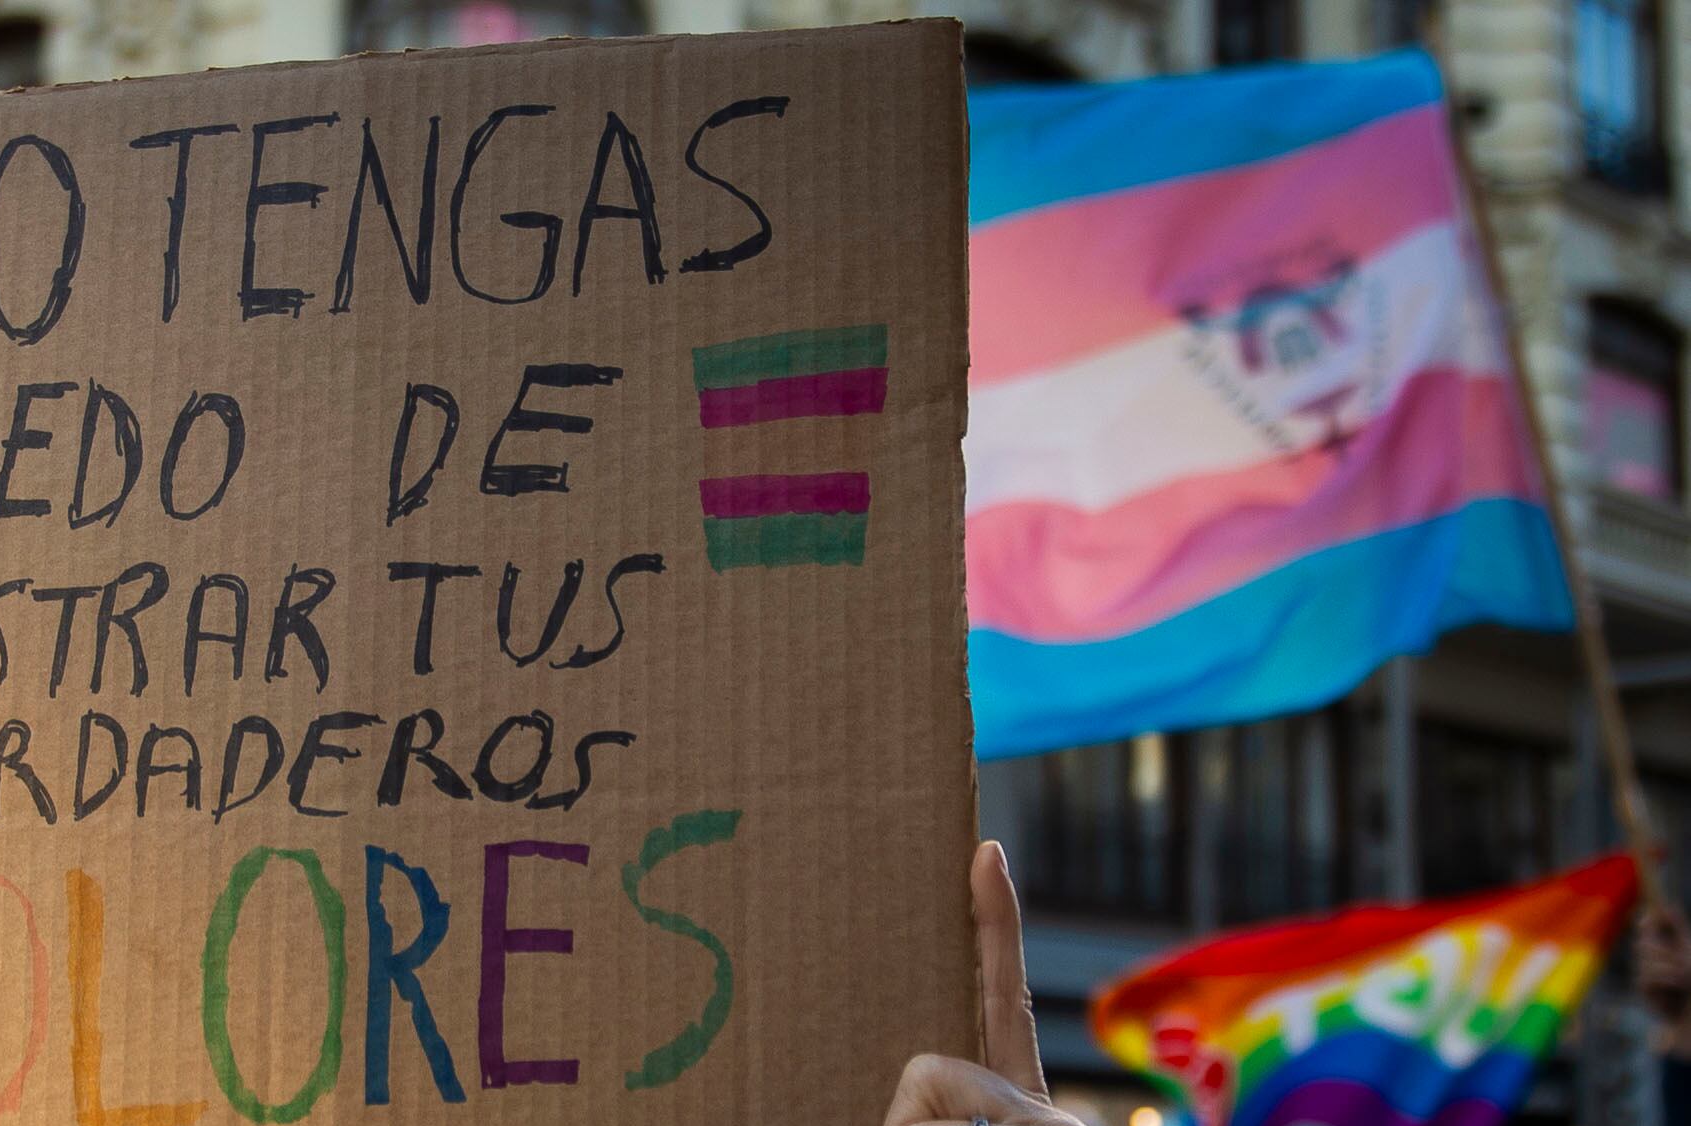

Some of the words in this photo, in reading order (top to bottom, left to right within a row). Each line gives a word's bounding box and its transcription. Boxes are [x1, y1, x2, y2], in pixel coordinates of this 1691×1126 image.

[129, 96, 791, 323] TENGAS
[387, 364, 624, 527] DE
[387, 553, 666, 675] TUS
